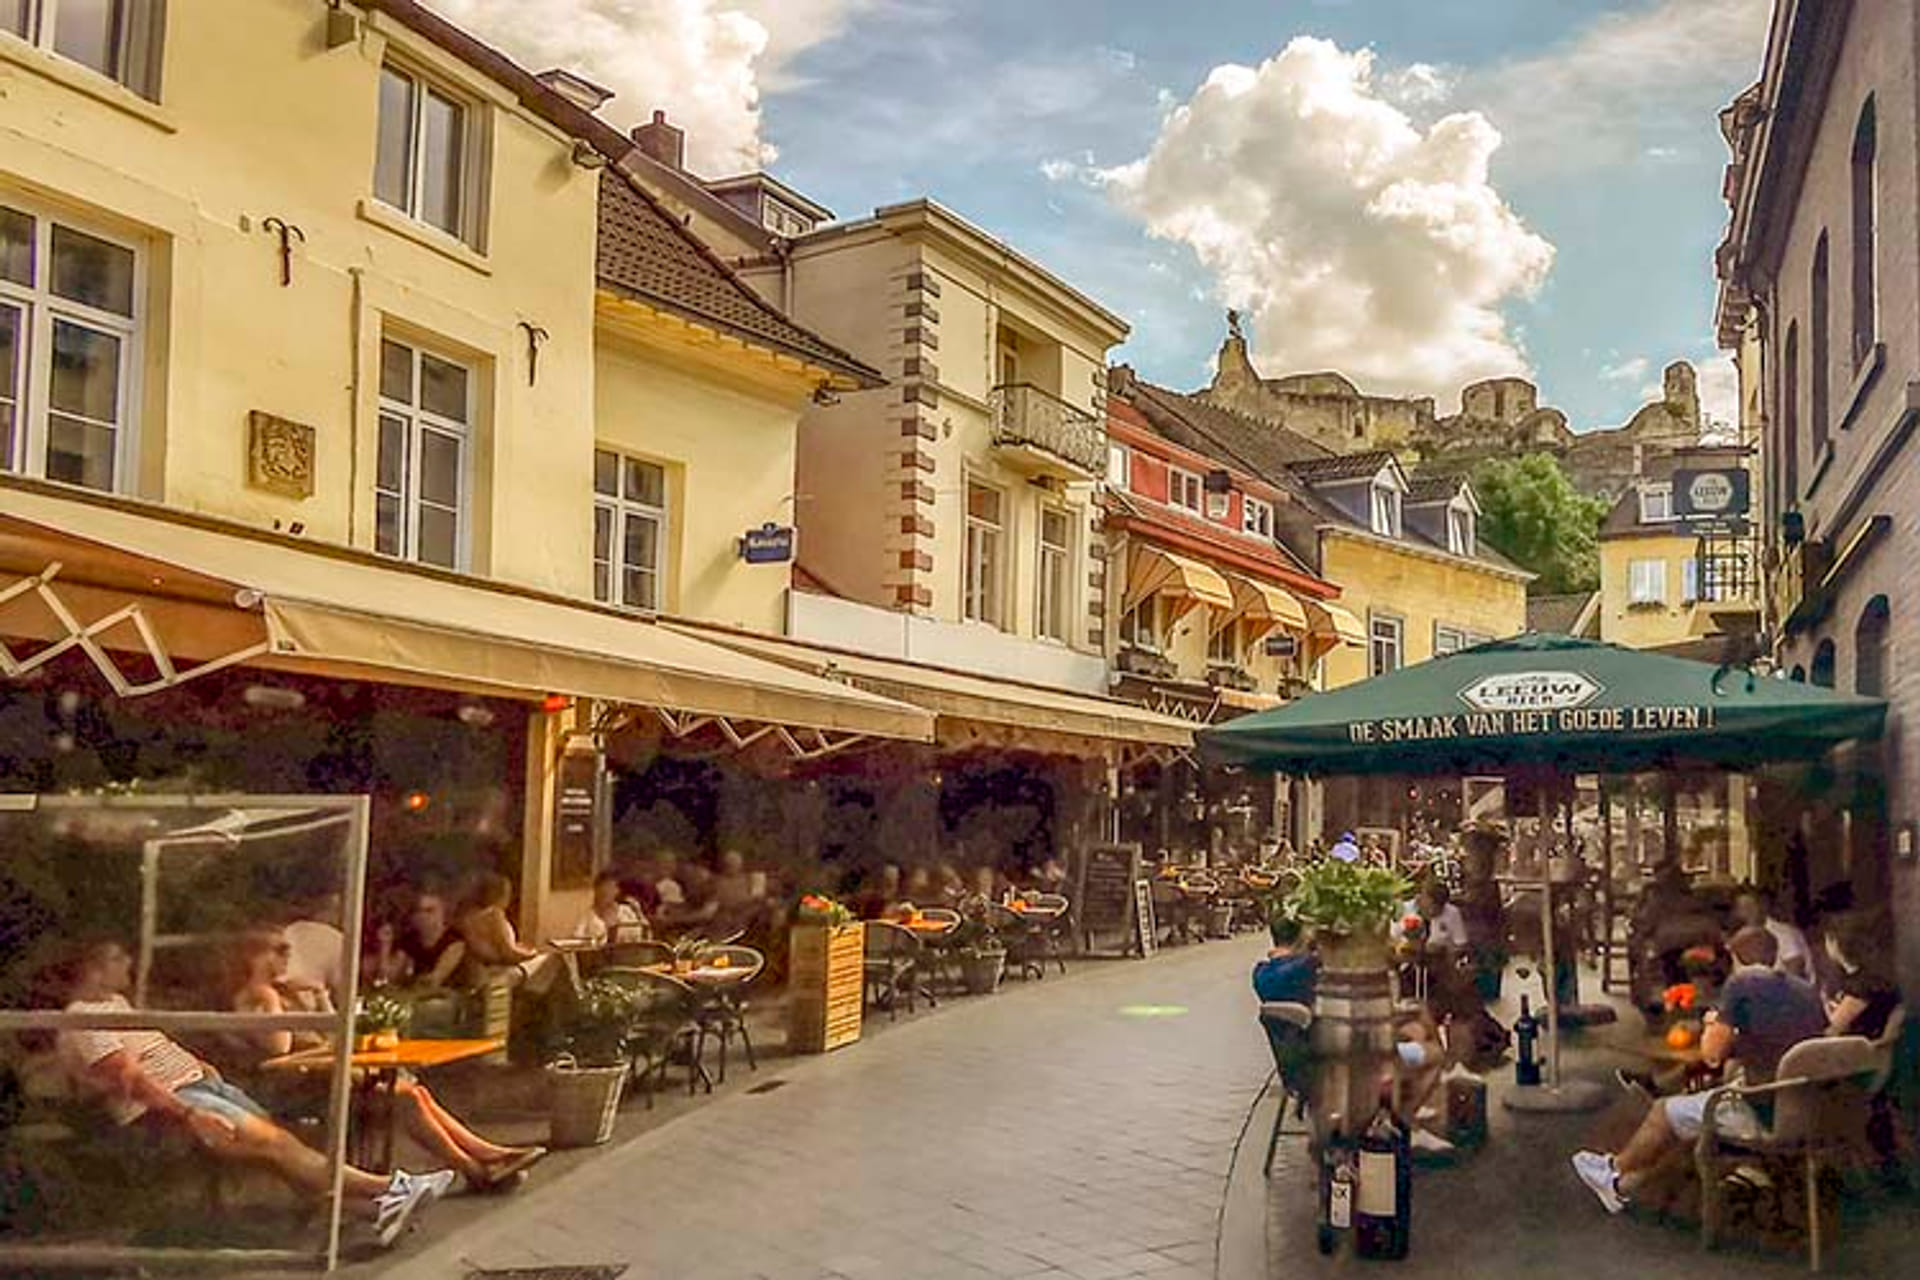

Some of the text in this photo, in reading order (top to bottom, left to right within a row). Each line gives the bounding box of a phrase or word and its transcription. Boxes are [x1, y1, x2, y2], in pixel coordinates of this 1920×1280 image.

[1479, 684, 1582, 697] LEEUW
[1350, 721, 1375, 743] DE
[1381, 714, 1458, 742] SMAAK
[1465, 711, 1505, 736] VAN
[1512, 710, 1554, 734] HET
[1558, 706, 1625, 733] GOEDE
[1632, 704, 1700, 730] LEVEN
